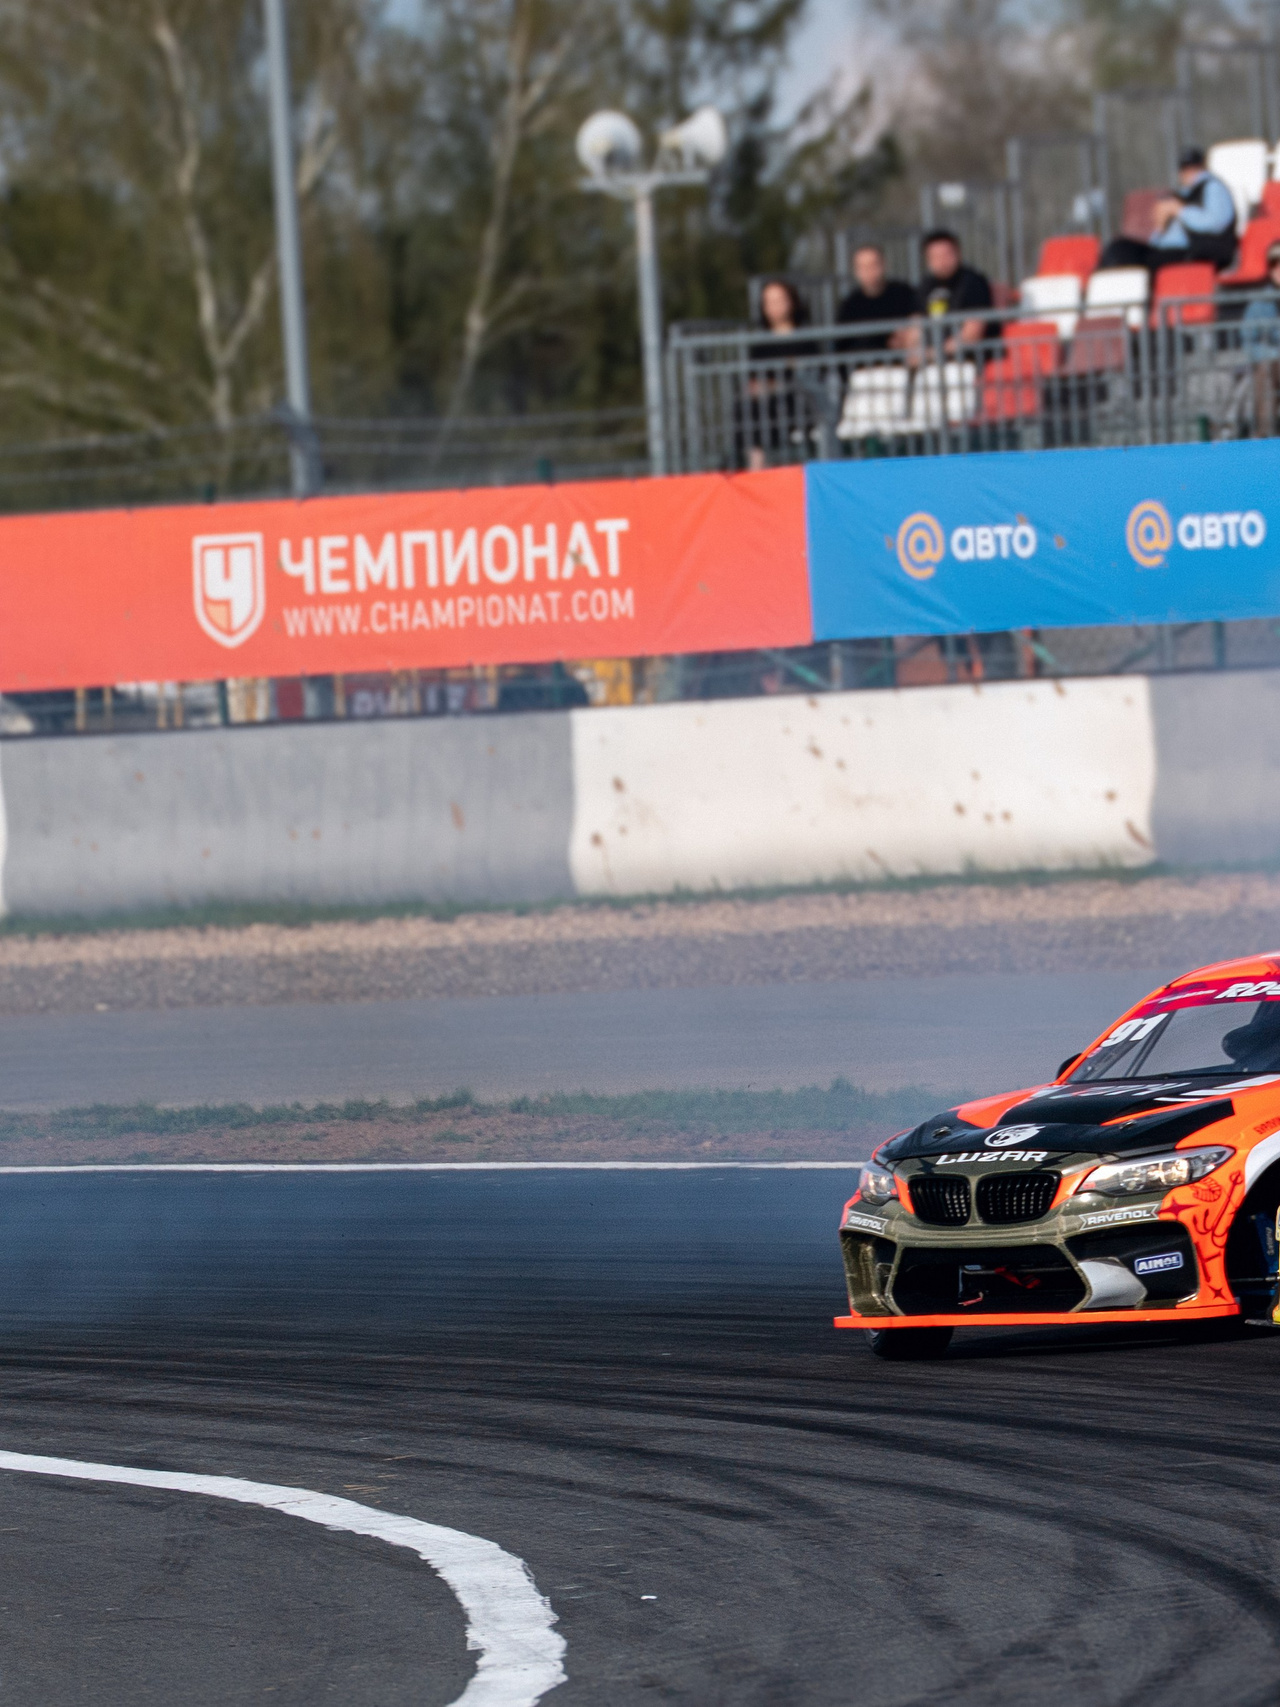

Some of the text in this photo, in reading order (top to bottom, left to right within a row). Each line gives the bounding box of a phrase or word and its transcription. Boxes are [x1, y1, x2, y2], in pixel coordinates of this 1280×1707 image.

[279, 518, 629, 595] ЧЕМПИОНАТ
[283, 588, 635, 637] WWW.CHAMPIONAT.COM
[1101, 1013, 1169, 1048] 91
[936, 1151, 1048, 1165] LUZAR
[849, 1215, 883, 1231] RAVENOL
[1087, 1209, 1151, 1227] RAVENOL
[1138, 1255, 1181, 1272] AIMOL
